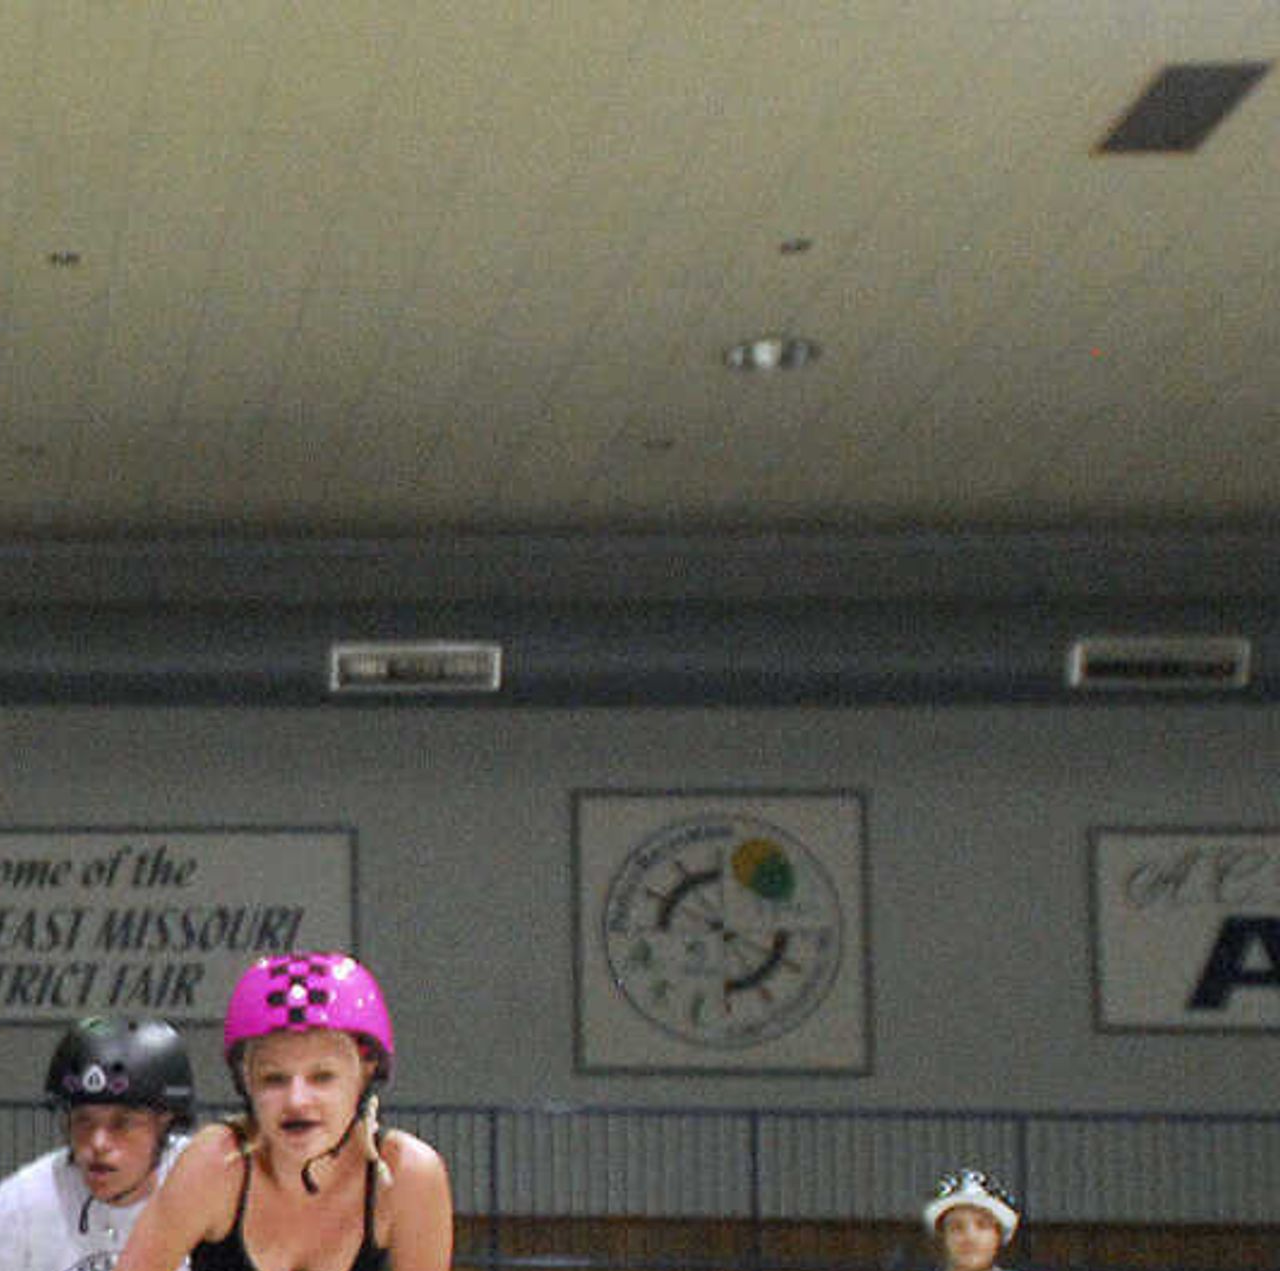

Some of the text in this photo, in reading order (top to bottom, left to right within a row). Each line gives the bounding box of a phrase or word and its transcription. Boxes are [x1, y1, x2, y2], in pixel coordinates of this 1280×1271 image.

[82, 844, 133, 888] of
[133, 845, 198, 888] the
[94, 906, 304, 951] MISSOURI
[108, 962, 206, 1006] FAIR
